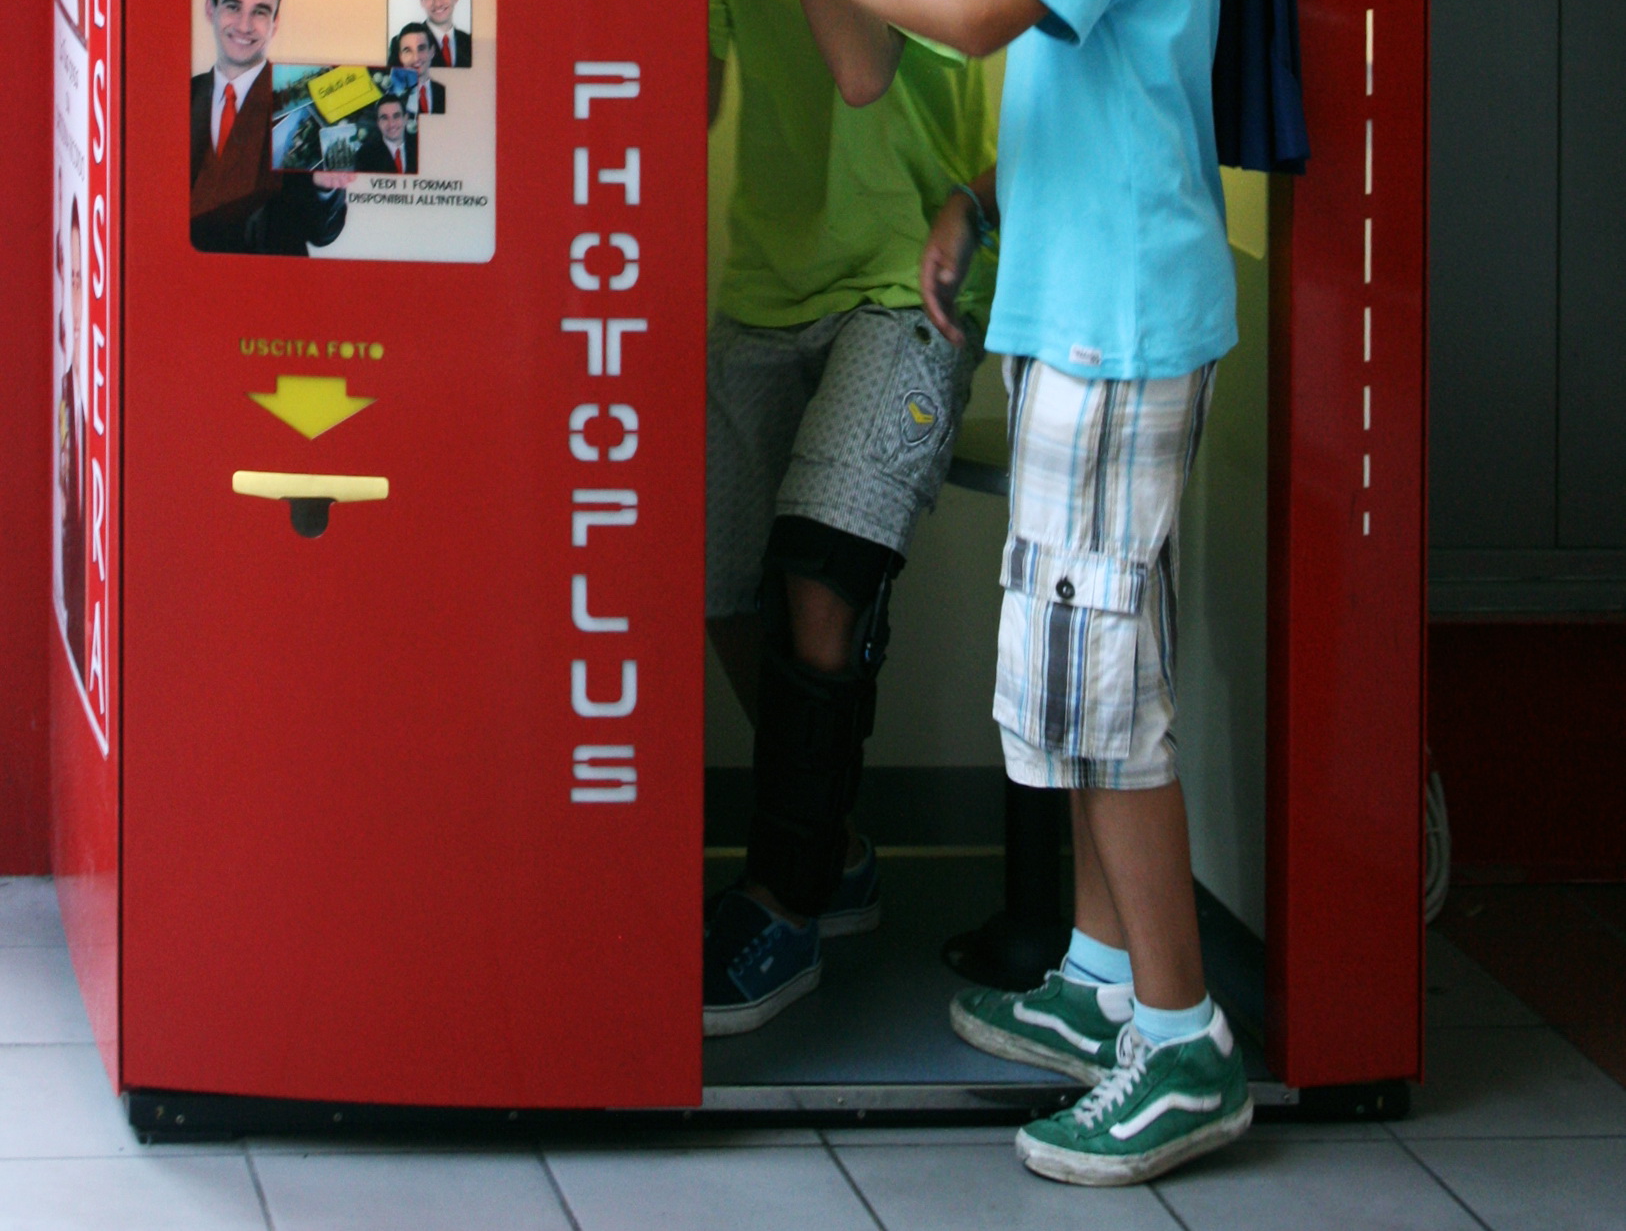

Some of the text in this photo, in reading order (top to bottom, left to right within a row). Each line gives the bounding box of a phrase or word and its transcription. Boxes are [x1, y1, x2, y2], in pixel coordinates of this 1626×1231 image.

[370, 177, 463, 191] VEDI I FORMATI
[348, 191, 489, 207] DISPONIBILI ALL'INTERNO
[239, 337, 385, 361] USCITA FOTO
